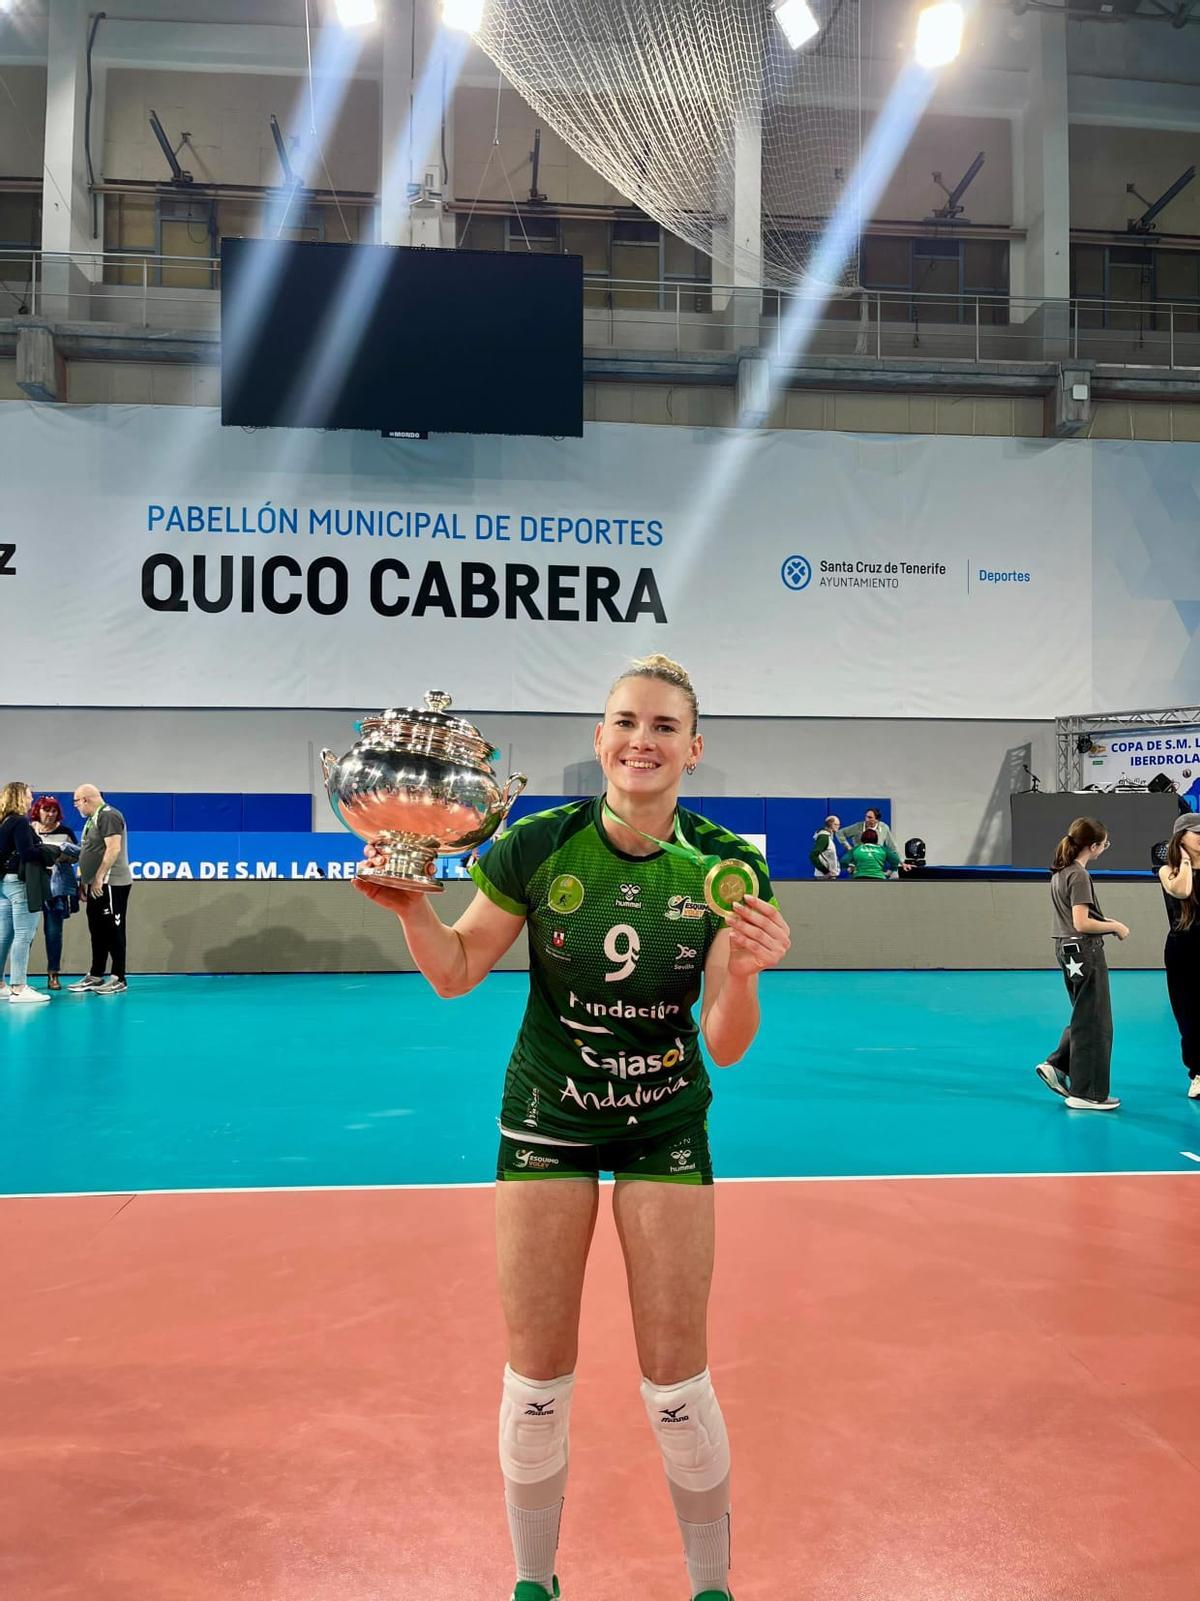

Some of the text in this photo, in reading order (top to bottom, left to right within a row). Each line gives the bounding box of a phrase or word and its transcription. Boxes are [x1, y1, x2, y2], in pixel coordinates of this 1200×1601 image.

[148, 501, 664, 546] PABELLÓN MUNICIPAL DE DEPORTES
[820, 560, 946, 575] Santa Cruz de Tenerife
[820, 577, 899, 589] AYUNTAMIENTO
[979, 569, 1031, 584] Deportes
[141, 552, 668, 624] QUICO CABRERA
[1111, 741, 1144, 753] COPA
[1147, 740, 1162, 751] DE
[1165, 738, 1192, 750] S.M.
[1130, 753, 1200, 766] IBERDROLA
[130, 861, 361, 879] COPA DE S.M. LA RE
[616, 900, 642, 909] hummel
[603, 924, 641, 982] 9
[670, 1163, 696, 1173] hummel
